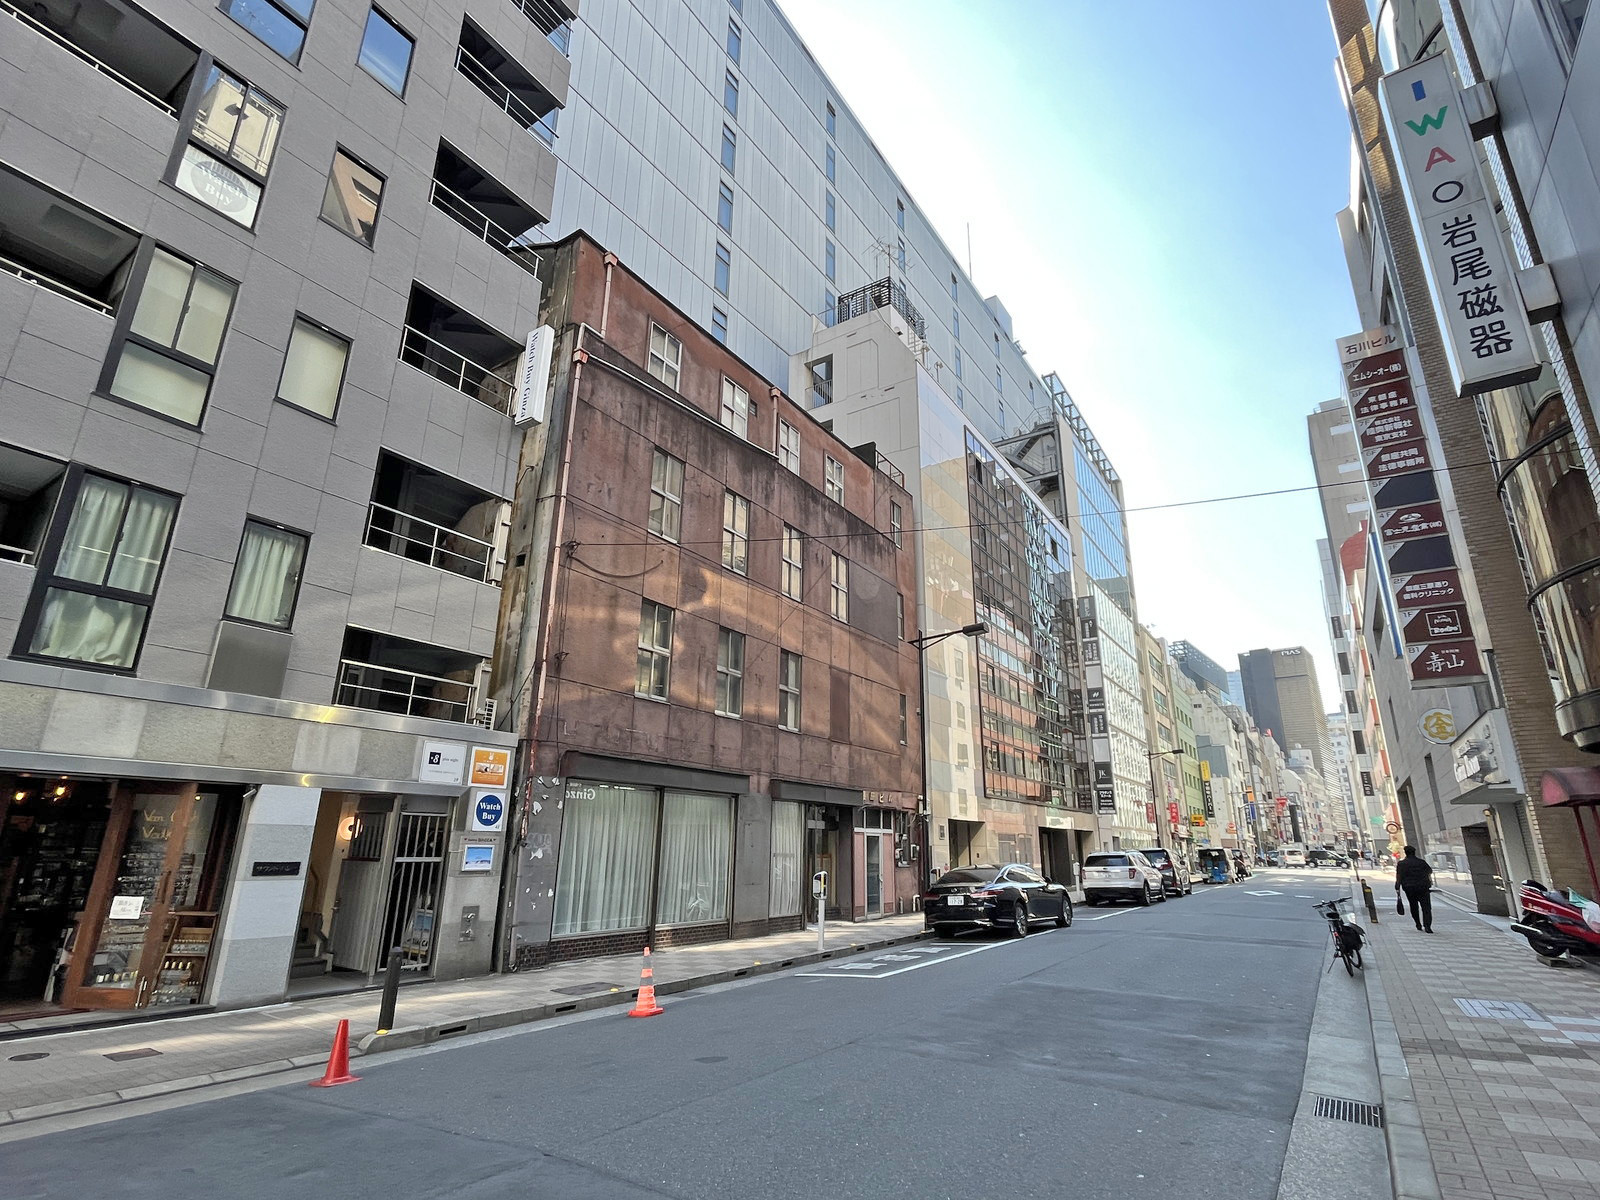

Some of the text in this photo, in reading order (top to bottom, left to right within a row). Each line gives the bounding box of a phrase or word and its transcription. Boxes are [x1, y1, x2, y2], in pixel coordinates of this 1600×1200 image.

[1405, 79, 1464, 203] IWAO
[202, 166, 243, 199] Watch
[205, 183, 233, 205] Buy
[1441, 213, 1514, 359] 岩尾磁器
[1345, 334, 1396, 355] 石川ビル
[525, 365, 534, 384] Buy
[1426, 651, 1465, 673] 青山
[479, 802, 501, 811] Watch
[482, 812, 496, 821] Buy
